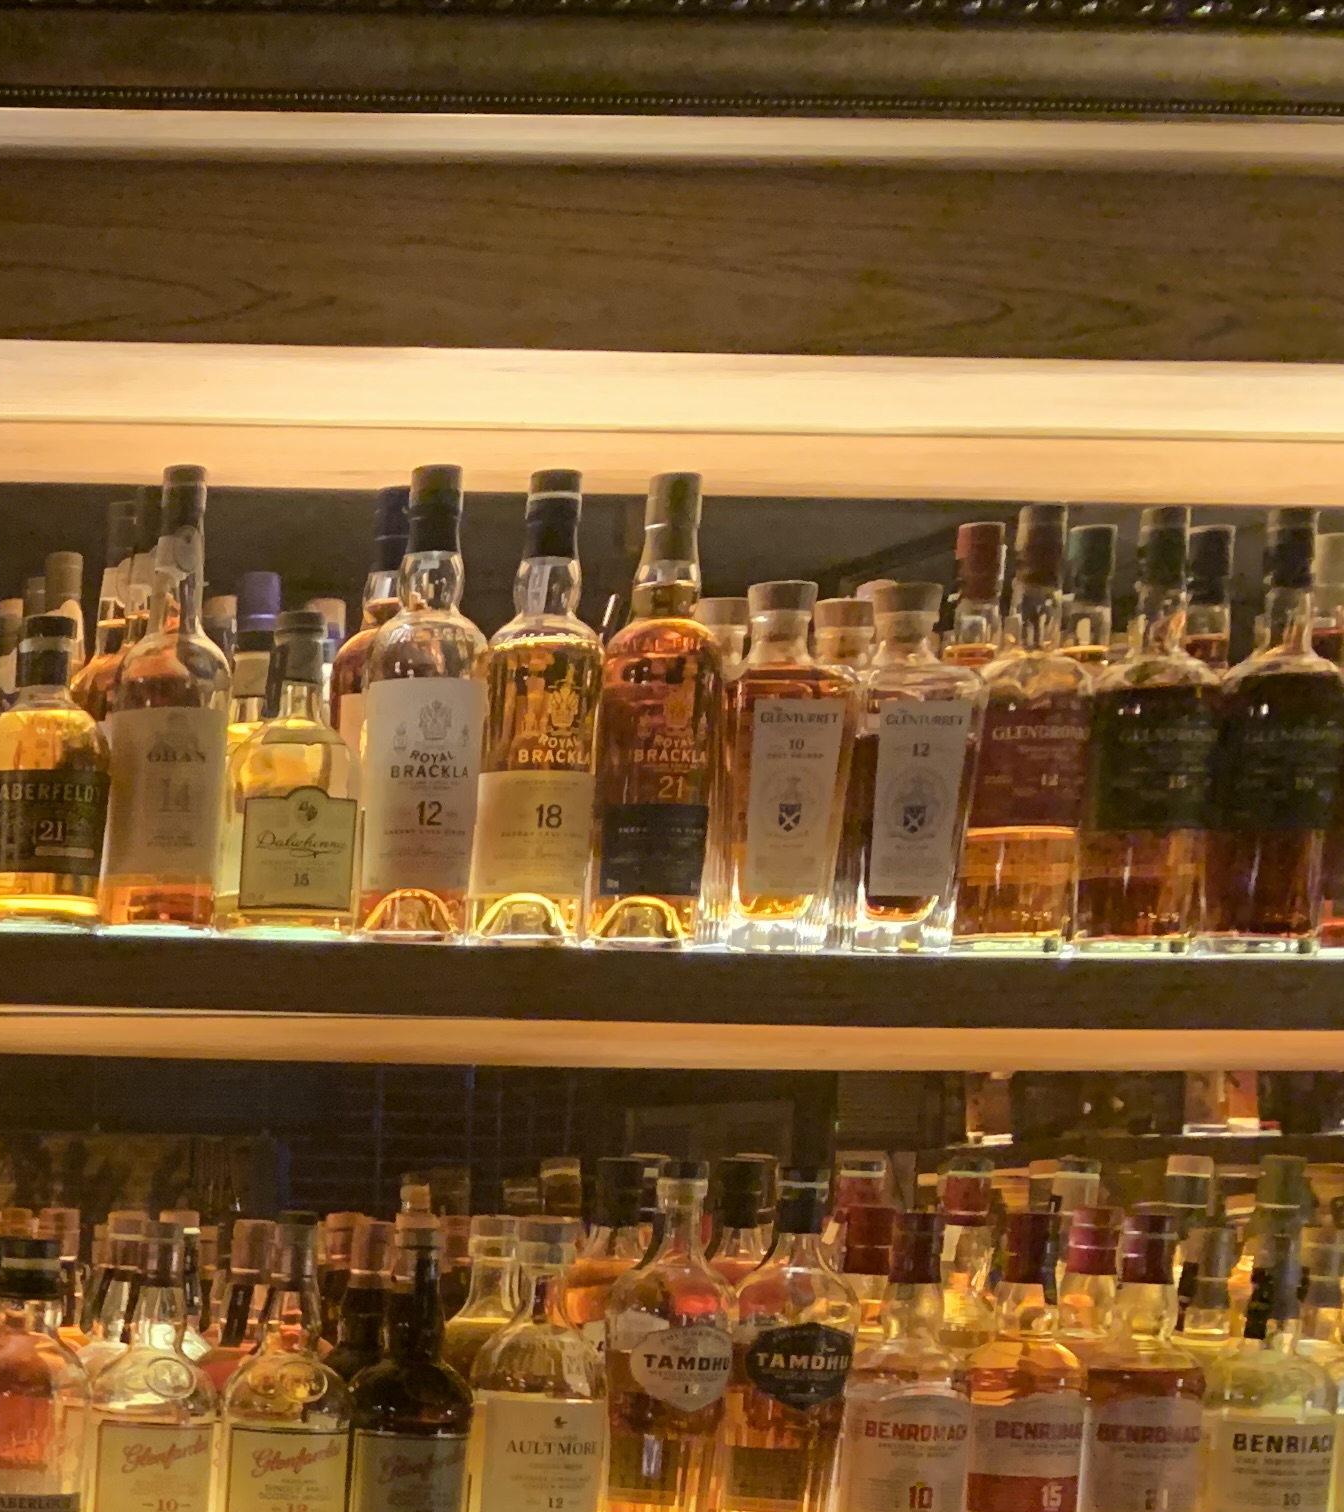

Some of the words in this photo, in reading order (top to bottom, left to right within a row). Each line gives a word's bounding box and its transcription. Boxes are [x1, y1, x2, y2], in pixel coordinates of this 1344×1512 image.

[761, 711, 839, 725] GLENTURRET
[886, 714, 963, 727] GLENTURRET
[538, 734, 582, 749] ROYAL
[788, 739, 805, 751] 10
[147, 750, 206, 763] OBAN
[410, 750, 456, 763] ROYAL
[518, 749, 591, 765] BRACKLA
[634, 749, 707, 762] BRACKLA
[911, 743, 929, 756] 12
[391, 765, 468, 779] BRACKLA
[658, 776, 683, 798] 21
[160, 778, 191, 812] 14
[416, 801, 443, 826] 12
[535, 804, 563, 829] 18
[39, 820, 62, 841] 21
[643, 1354, 730, 1370] TAMDHU
[756, 1352, 850, 1370] TAMDHU
[506, 1439, 598, 1457] AULTMORE
[908, 1484, 933, 1509] 10
[1041, 1483, 1063, 1507] 15
[1282, 1493, 1301, 1506] 10
[155, 1500, 178, 1512] 10
[547, 1497, 564, 1509] 12
